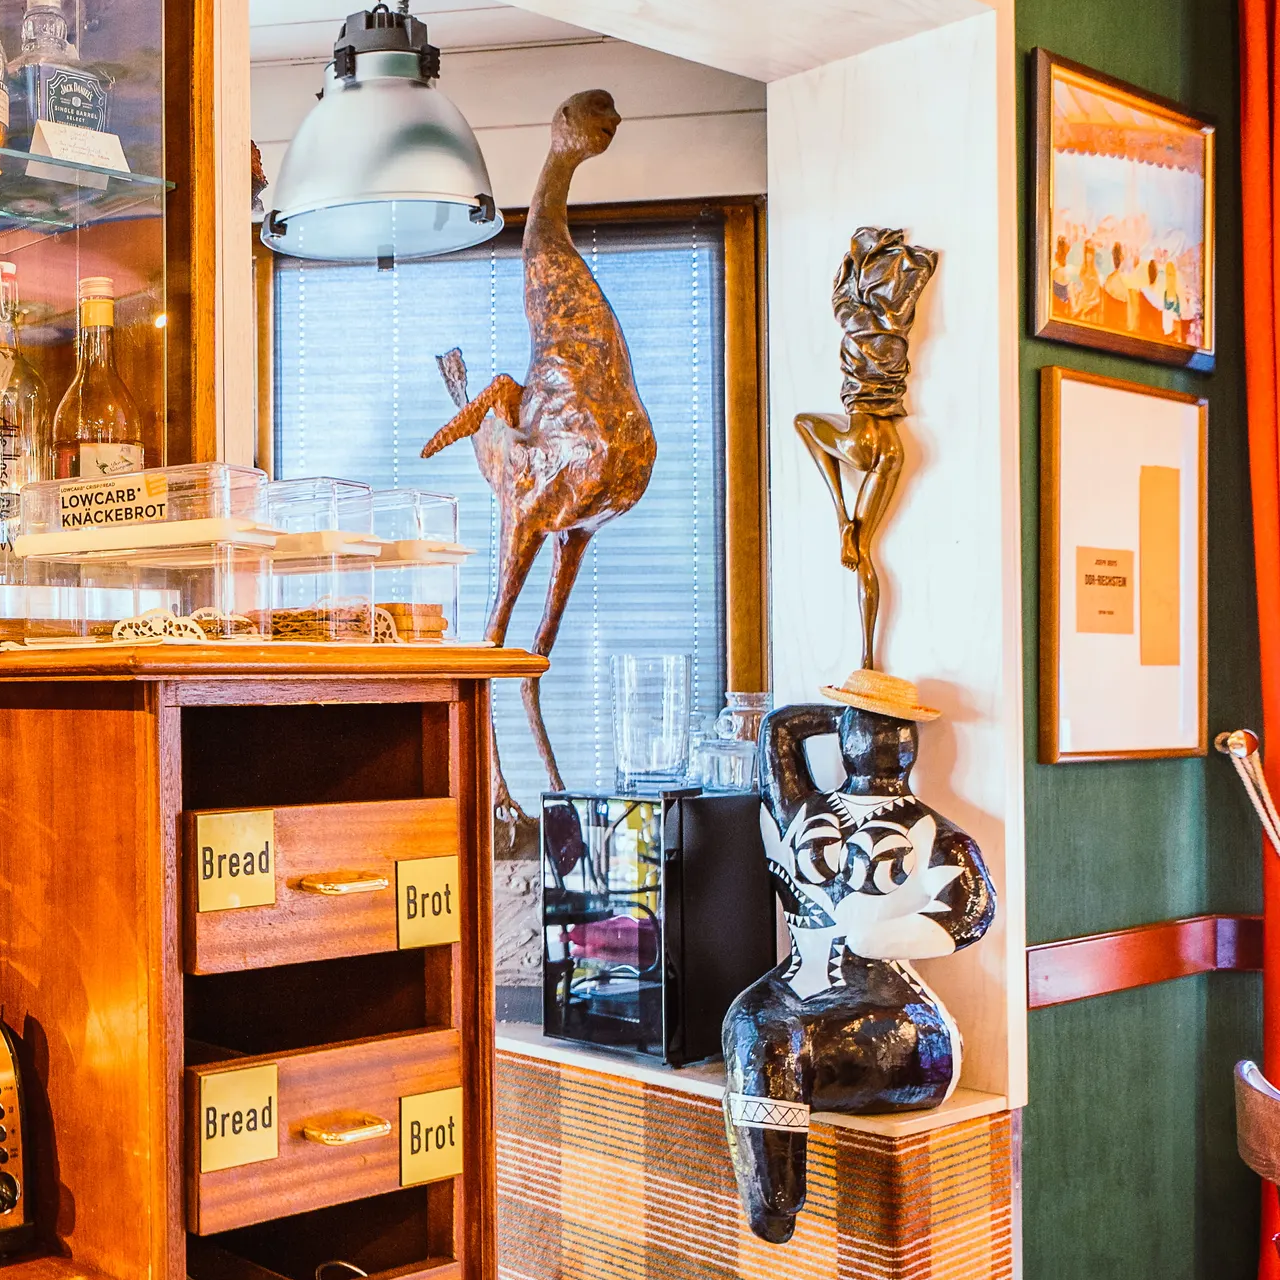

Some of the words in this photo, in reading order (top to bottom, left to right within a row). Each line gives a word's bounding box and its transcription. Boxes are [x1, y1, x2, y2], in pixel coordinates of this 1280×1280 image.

[60, 84, 74, 95] JACK
[54, 106, 75, 115] SINGLE
[76, 109, 98, 120] BARREL
[66, 115, 85, 123] SELECT
[62, 503, 166, 528] KNÄCKEBROT
[202, 841, 270, 880] Bread
[406, 883, 452, 919] Brot
[206, 1096, 273, 1139] Bread
[410, 1115, 456, 1155] Brot
